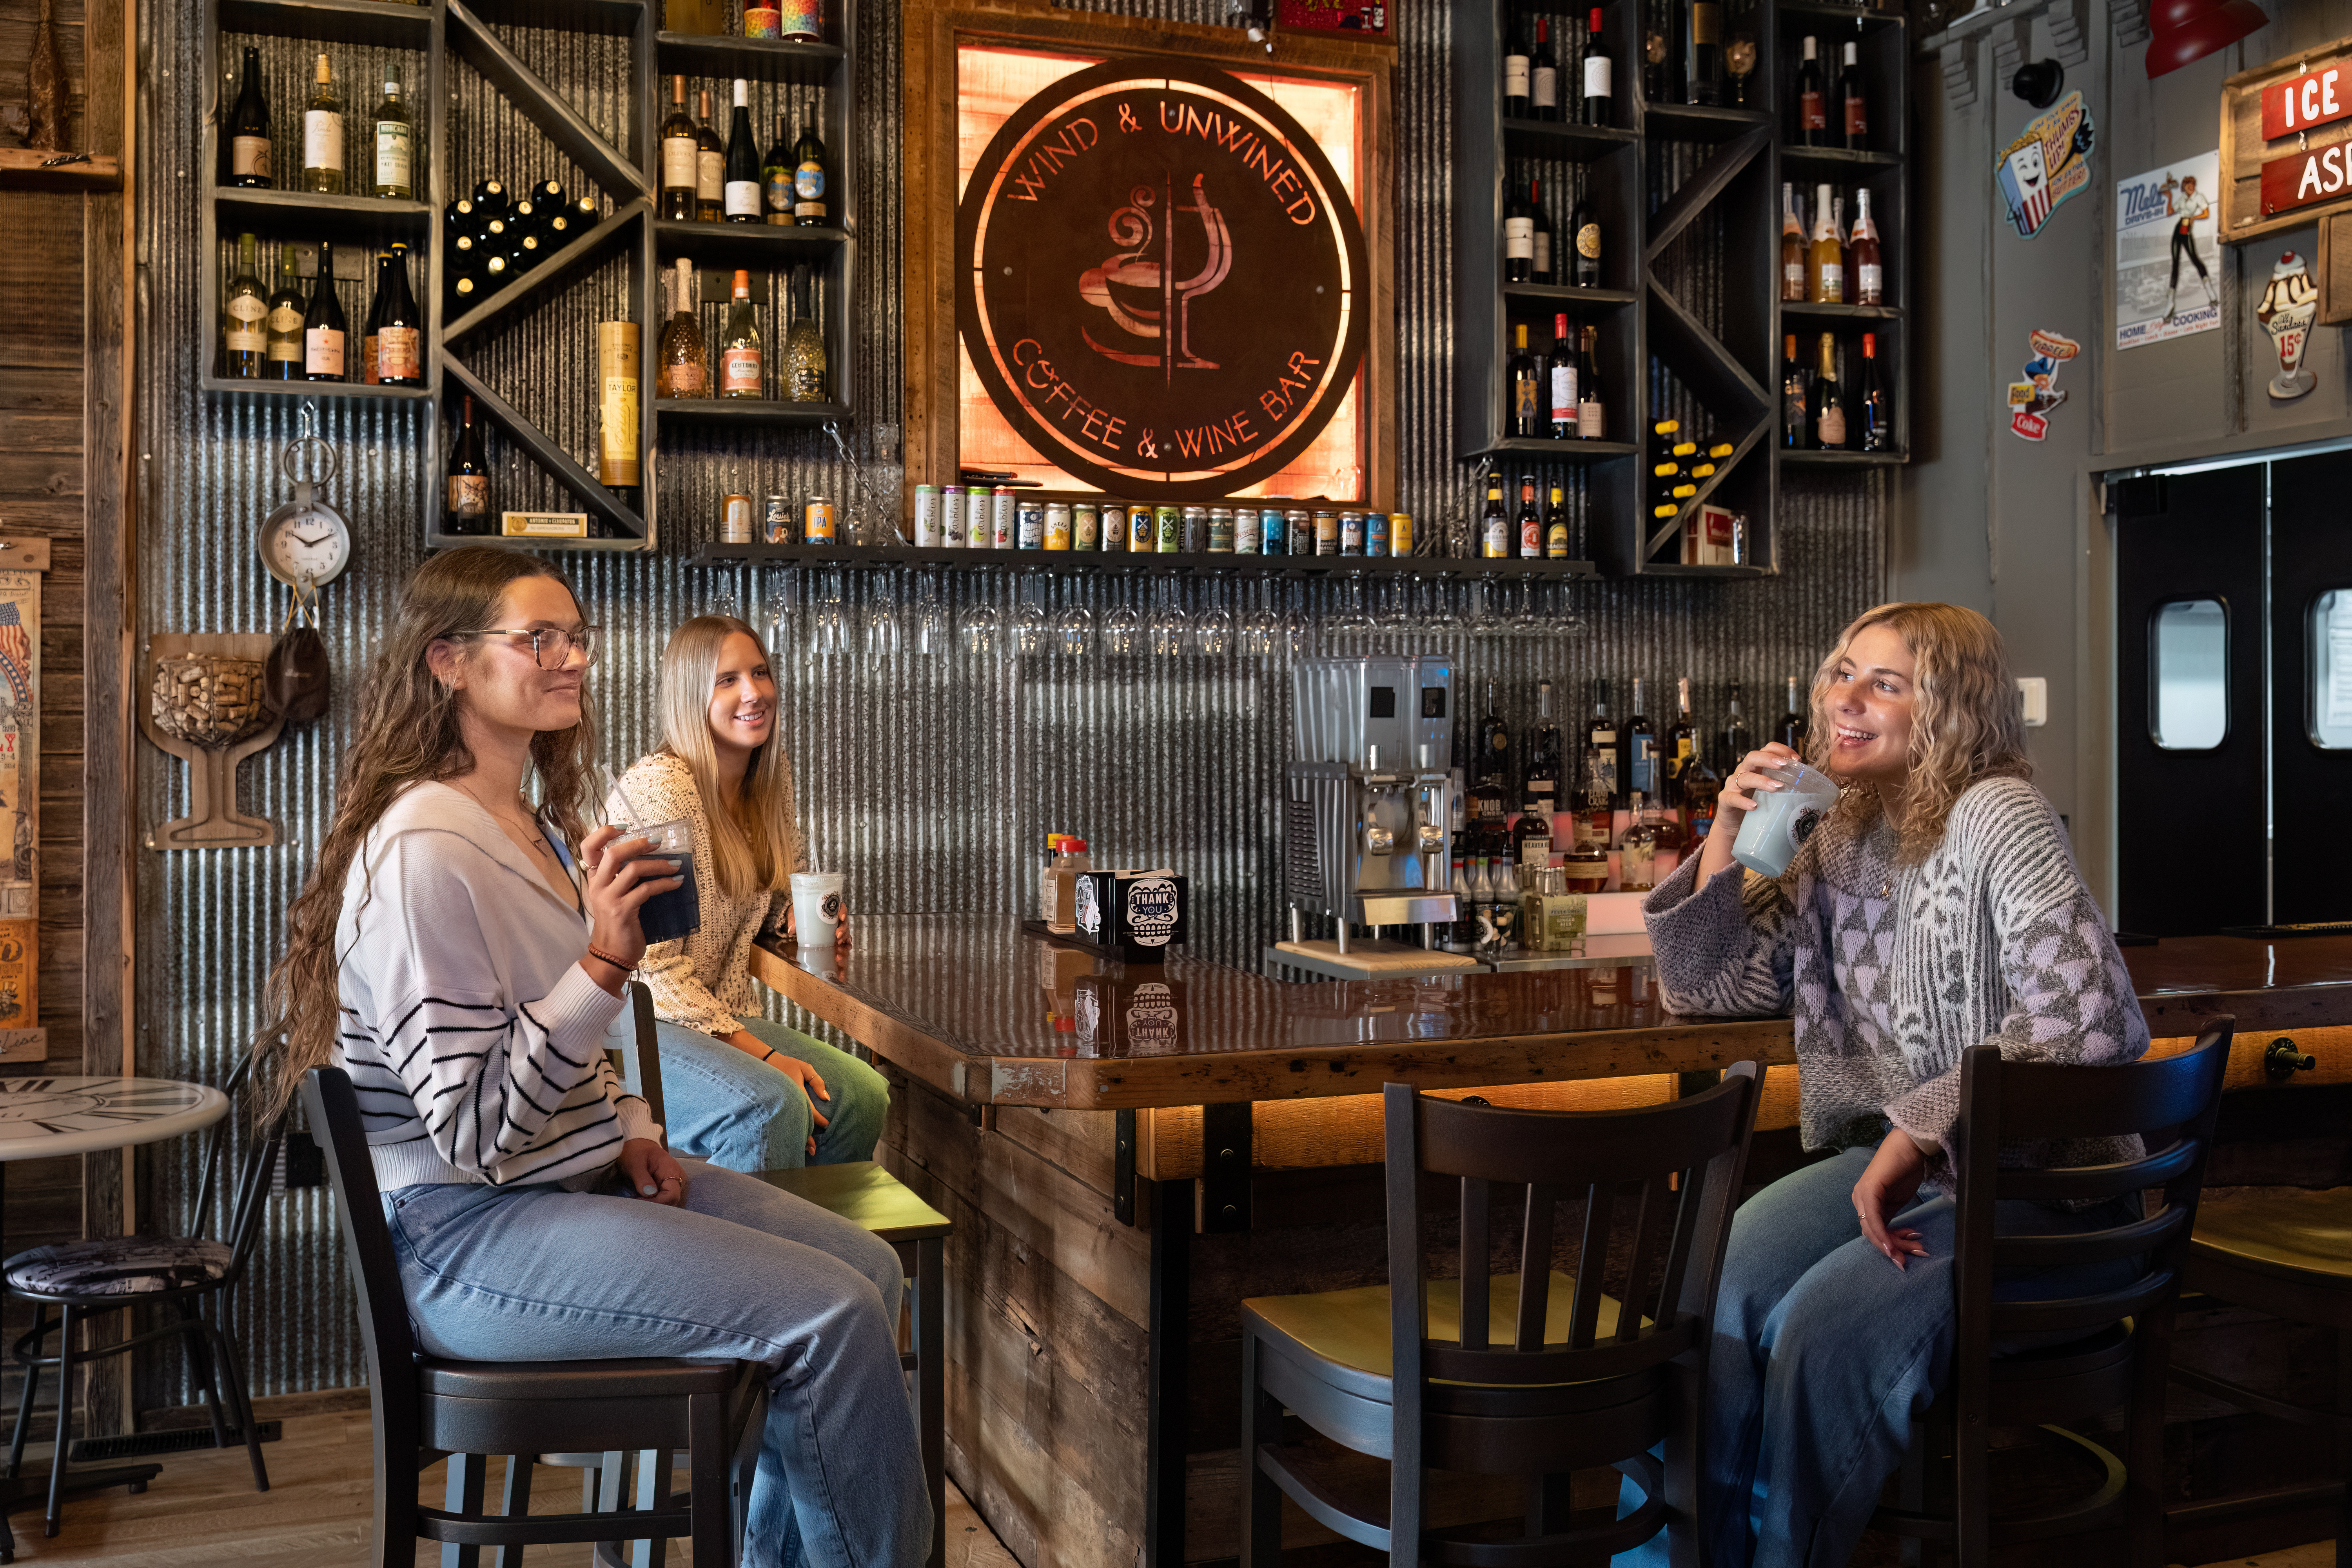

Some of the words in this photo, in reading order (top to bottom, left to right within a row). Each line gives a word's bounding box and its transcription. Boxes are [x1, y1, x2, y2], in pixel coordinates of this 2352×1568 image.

[2285, 69, 2339, 128] ICE
[1007, 117, 1099, 203] WIND
[1118, 102, 1143, 133] &
[1160, 100, 1316, 226] UNWINED
[2120, 325, 2146, 340] HOME
[2173, 307, 2218, 327] COOKING
[1012, 338, 1127, 451] COFFEE
[1137, 428, 1159, 459] &
[1175, 410, 1258, 459] WINE
[1259, 350, 1320, 421] BAR
[2016, 414, 2041, 434] Coke
[814, 516, 826, 528] IPA
[1135, 893, 1169, 904] THANK
[1142, 906, 1162, 914] YOU
